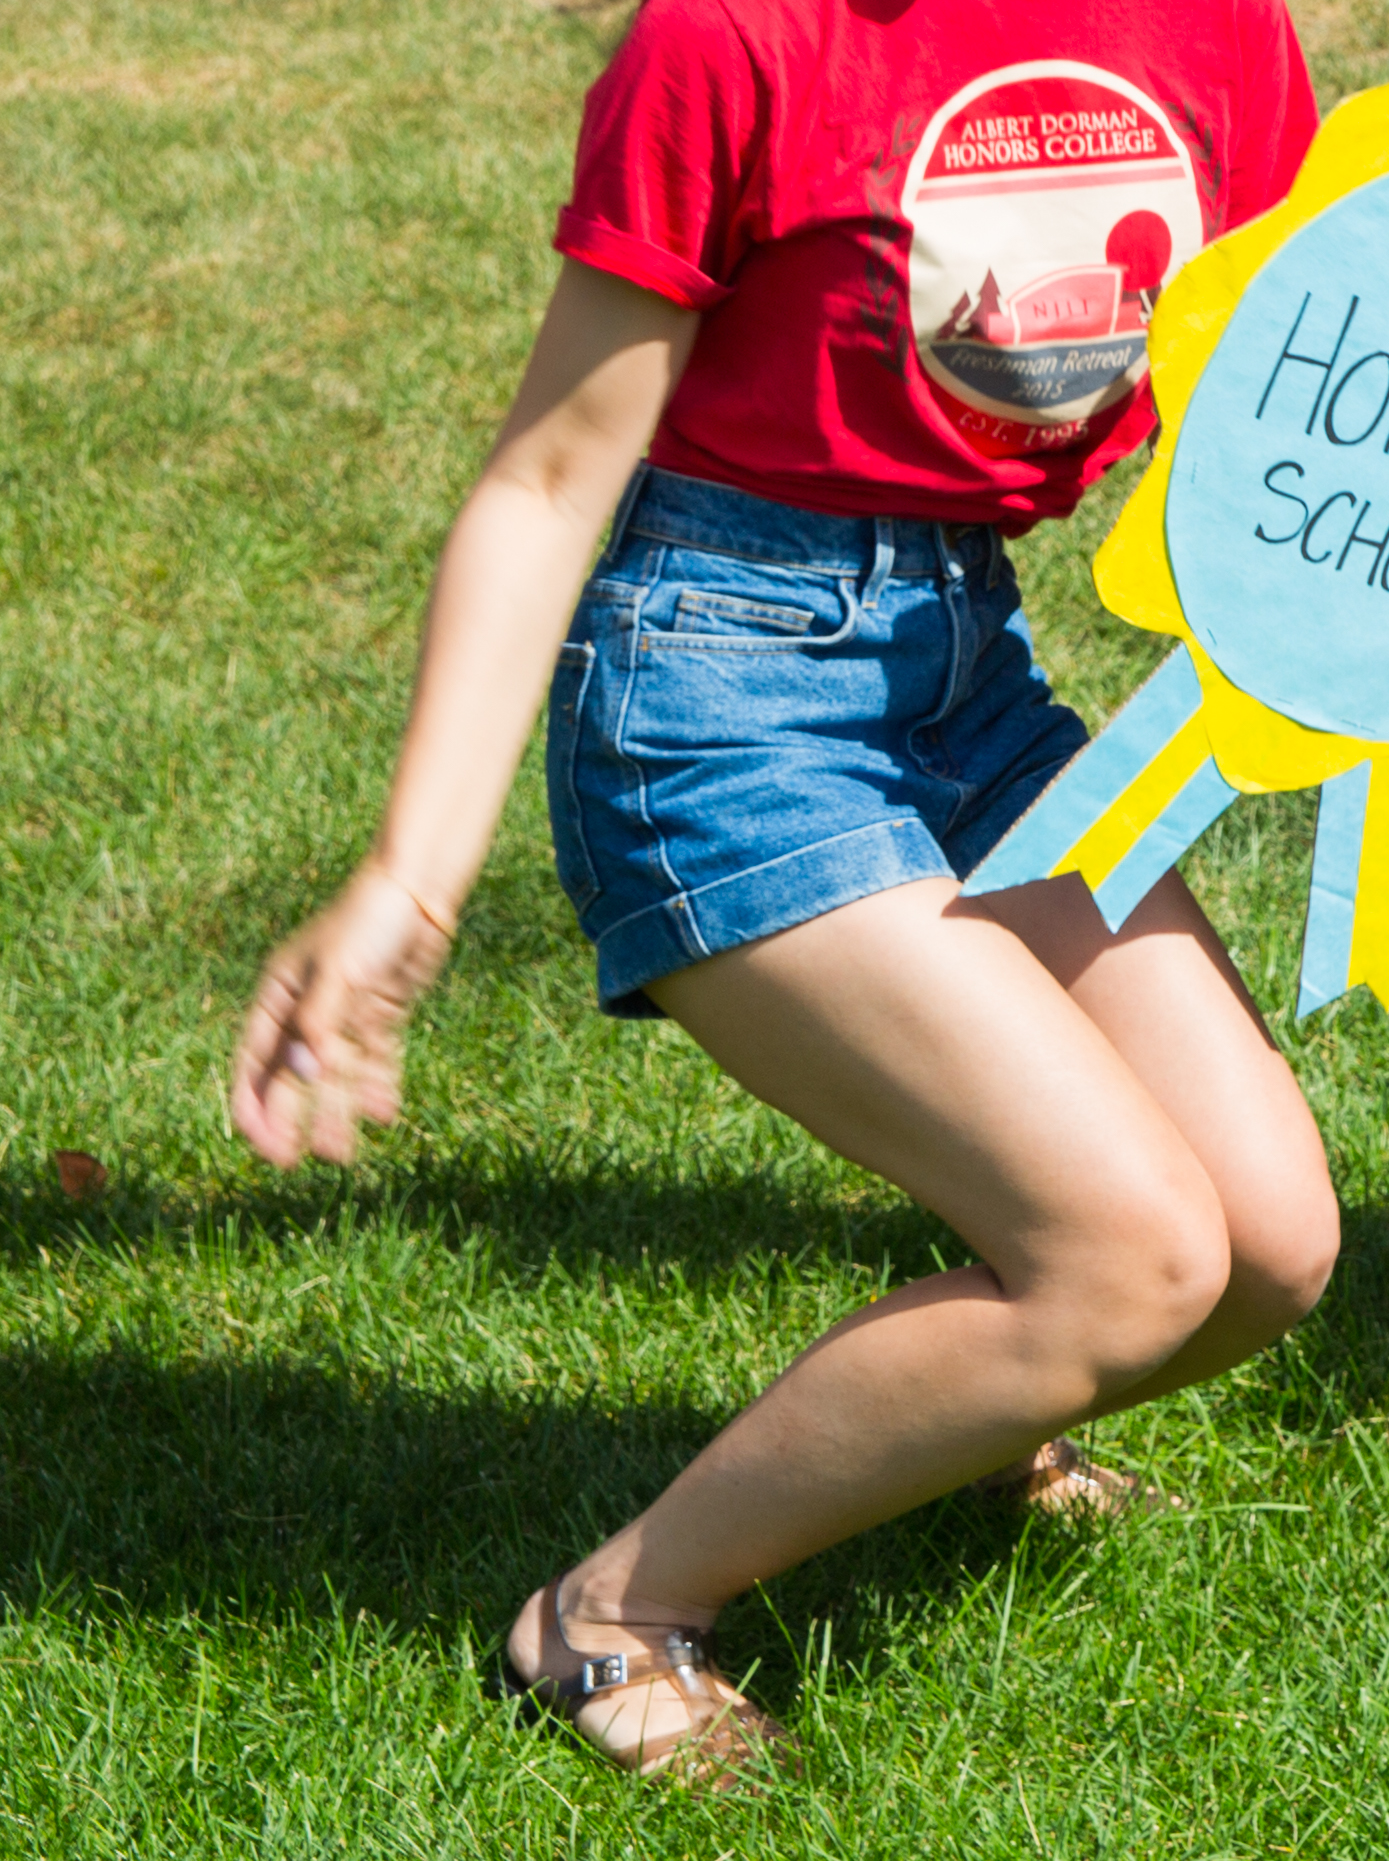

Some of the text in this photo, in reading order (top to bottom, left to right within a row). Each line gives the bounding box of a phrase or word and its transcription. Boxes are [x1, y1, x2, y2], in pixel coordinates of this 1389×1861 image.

[962, 108, 1138, 142] ALBERT DORMAN
[944, 128, 1157, 169] HONORS COLLEGE
[950, 345, 1132, 376] Freshman Retreat
[1012, 379, 1066, 400] 2015
